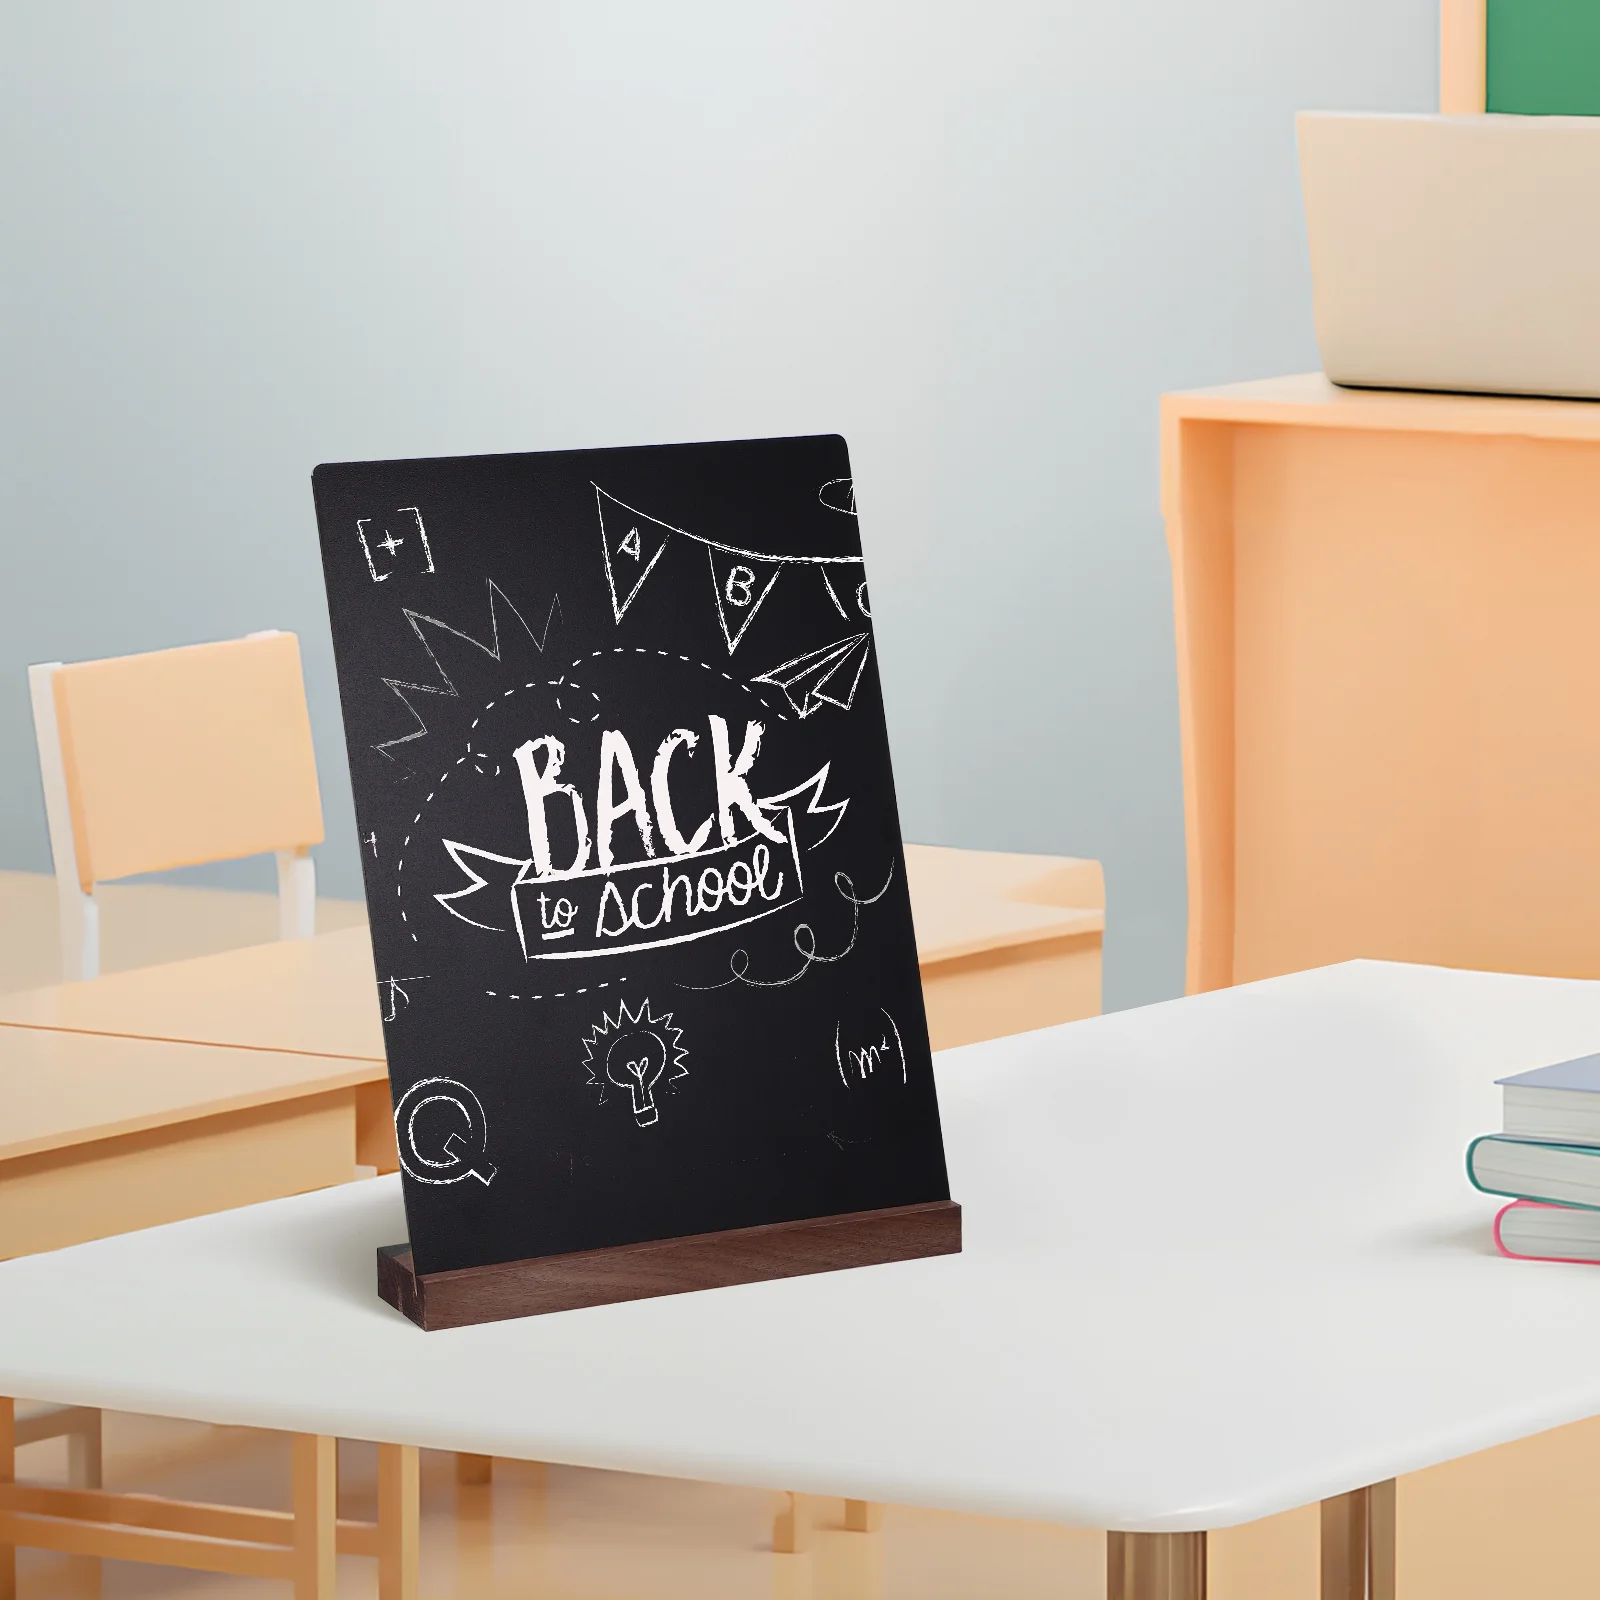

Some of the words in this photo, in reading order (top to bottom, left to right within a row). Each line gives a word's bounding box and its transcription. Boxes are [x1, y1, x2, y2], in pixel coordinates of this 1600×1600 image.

[617, 527, 642, 562] A
[725, 565, 757, 606] B
[512, 714, 788, 876] BACK
[536, 891, 579, 929] to
[595, 844, 784, 938] school
[396, 1076, 498, 1186] Q
